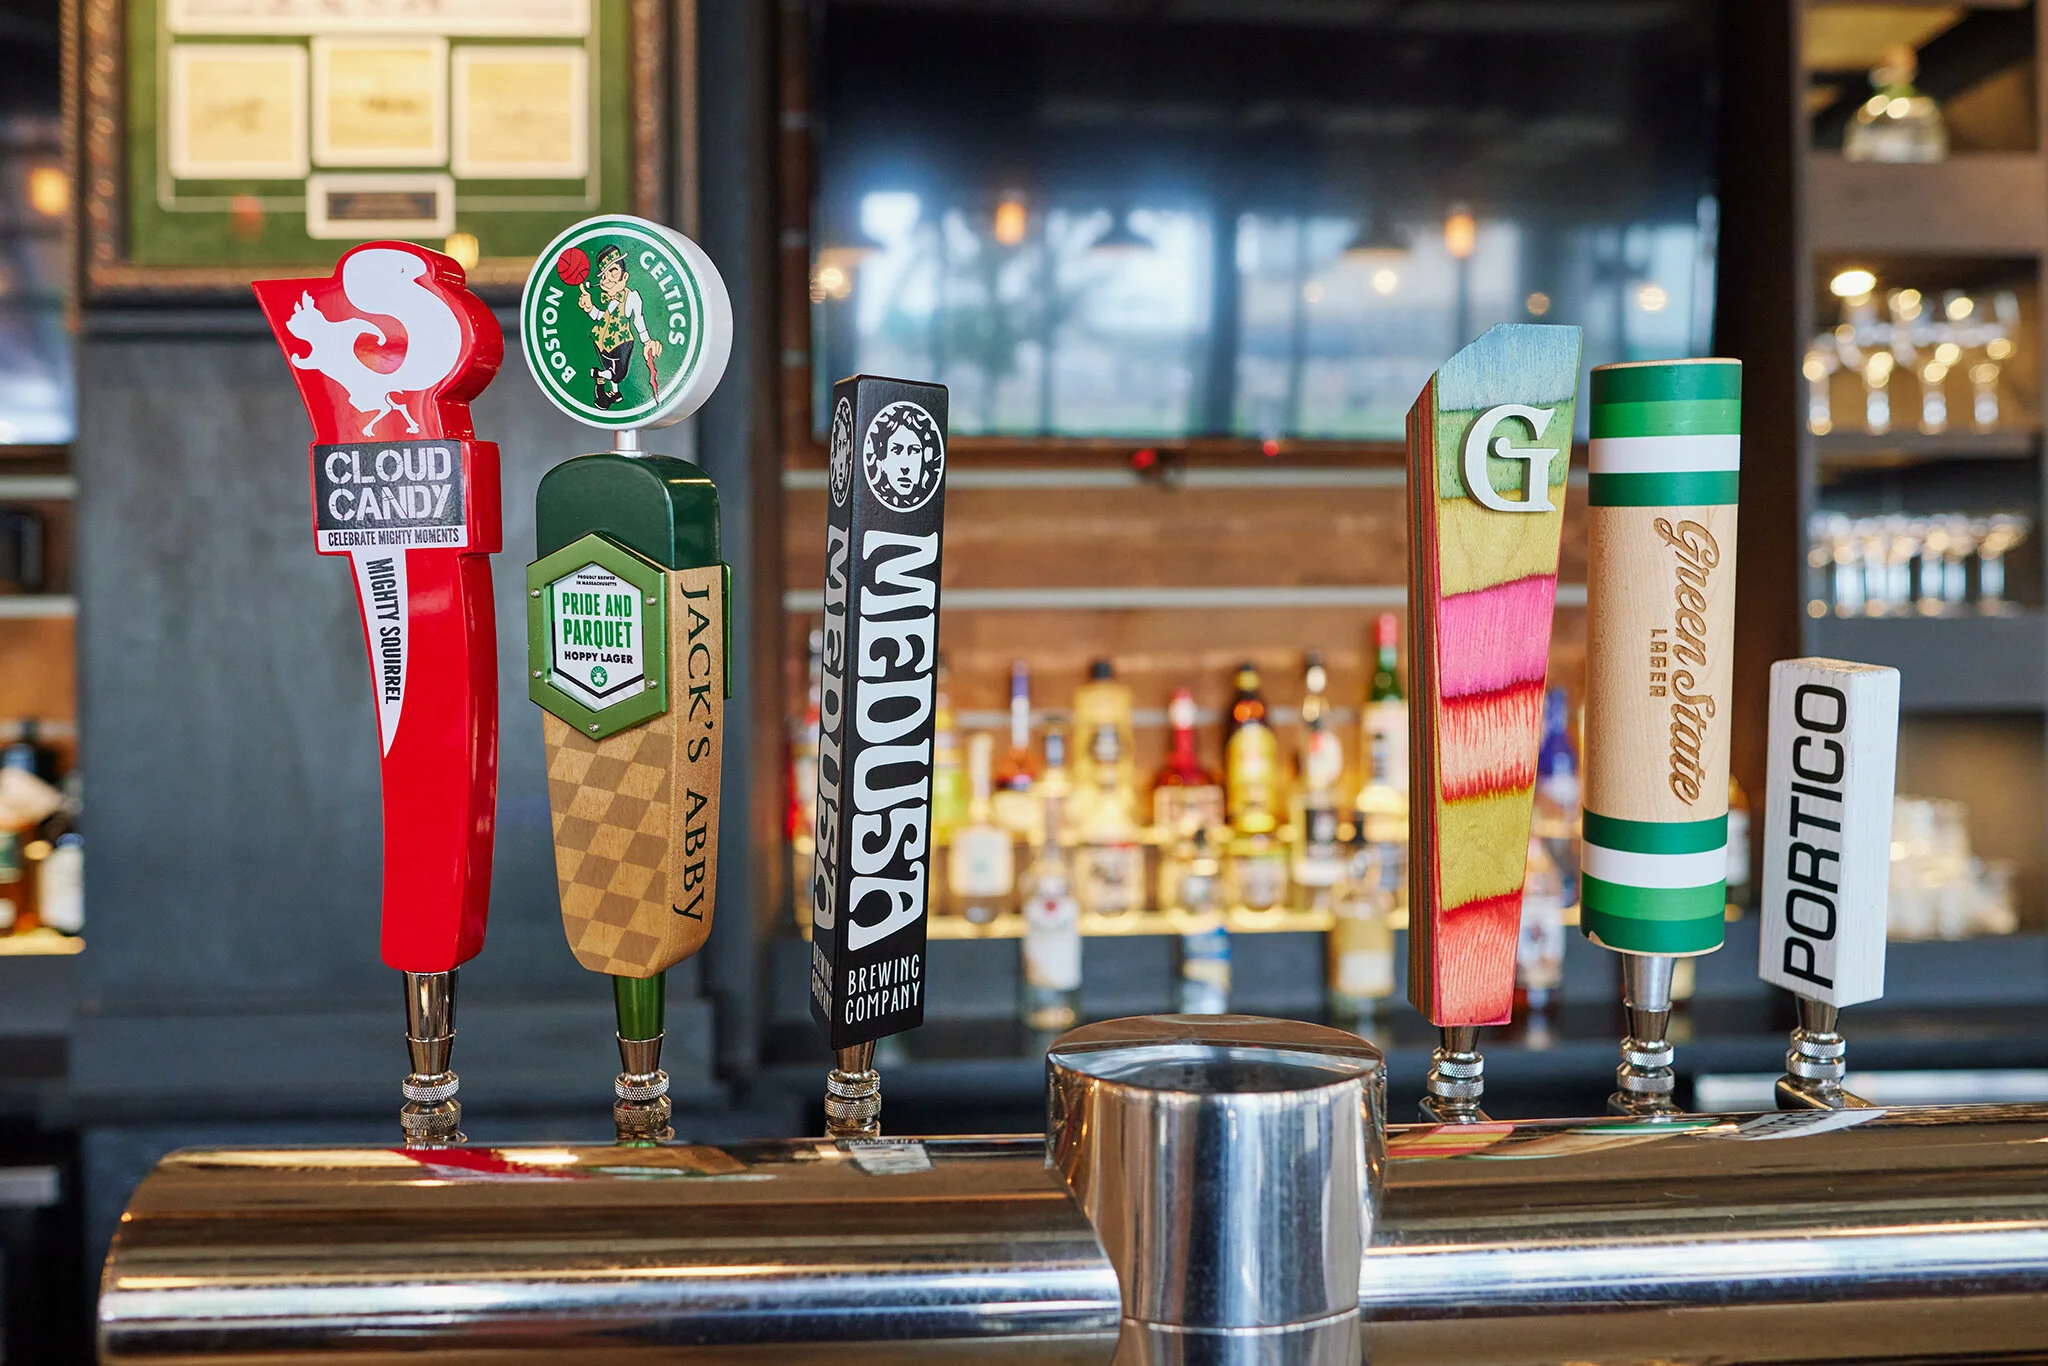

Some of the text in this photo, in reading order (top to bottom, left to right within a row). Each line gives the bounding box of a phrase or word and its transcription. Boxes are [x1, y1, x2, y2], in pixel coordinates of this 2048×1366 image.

[542, 251, 687, 384] BOSTON CELTICS
[325, 446, 452, 485] CLOUD
[1462, 404, 1560, 512] G
[328, 484, 452, 521] CANDY
[328, 528, 460, 547] CELEBRATE MIGHTY MOMENTS
[365, 557, 401, 705] MIGHTY SQUIRREL
[562, 592, 632, 618] PRIDE AND
[563, 618, 633, 650] PARQUET
[564, 650, 634, 664] HOPPY LAGER
[1650, 628, 1668, 698] LAGER
[1653, 517, 1720, 807] Green State
[673, 583, 714, 922] JACK'S ABBY
[814, 524, 849, 930] MEDUSA
[848, 530, 939, 951] MEDUSA
[1783, 683, 1847, 990] PORTICO
[845, 980, 921, 1025] COMPANY
[847, 954, 920, 996] BREWING
